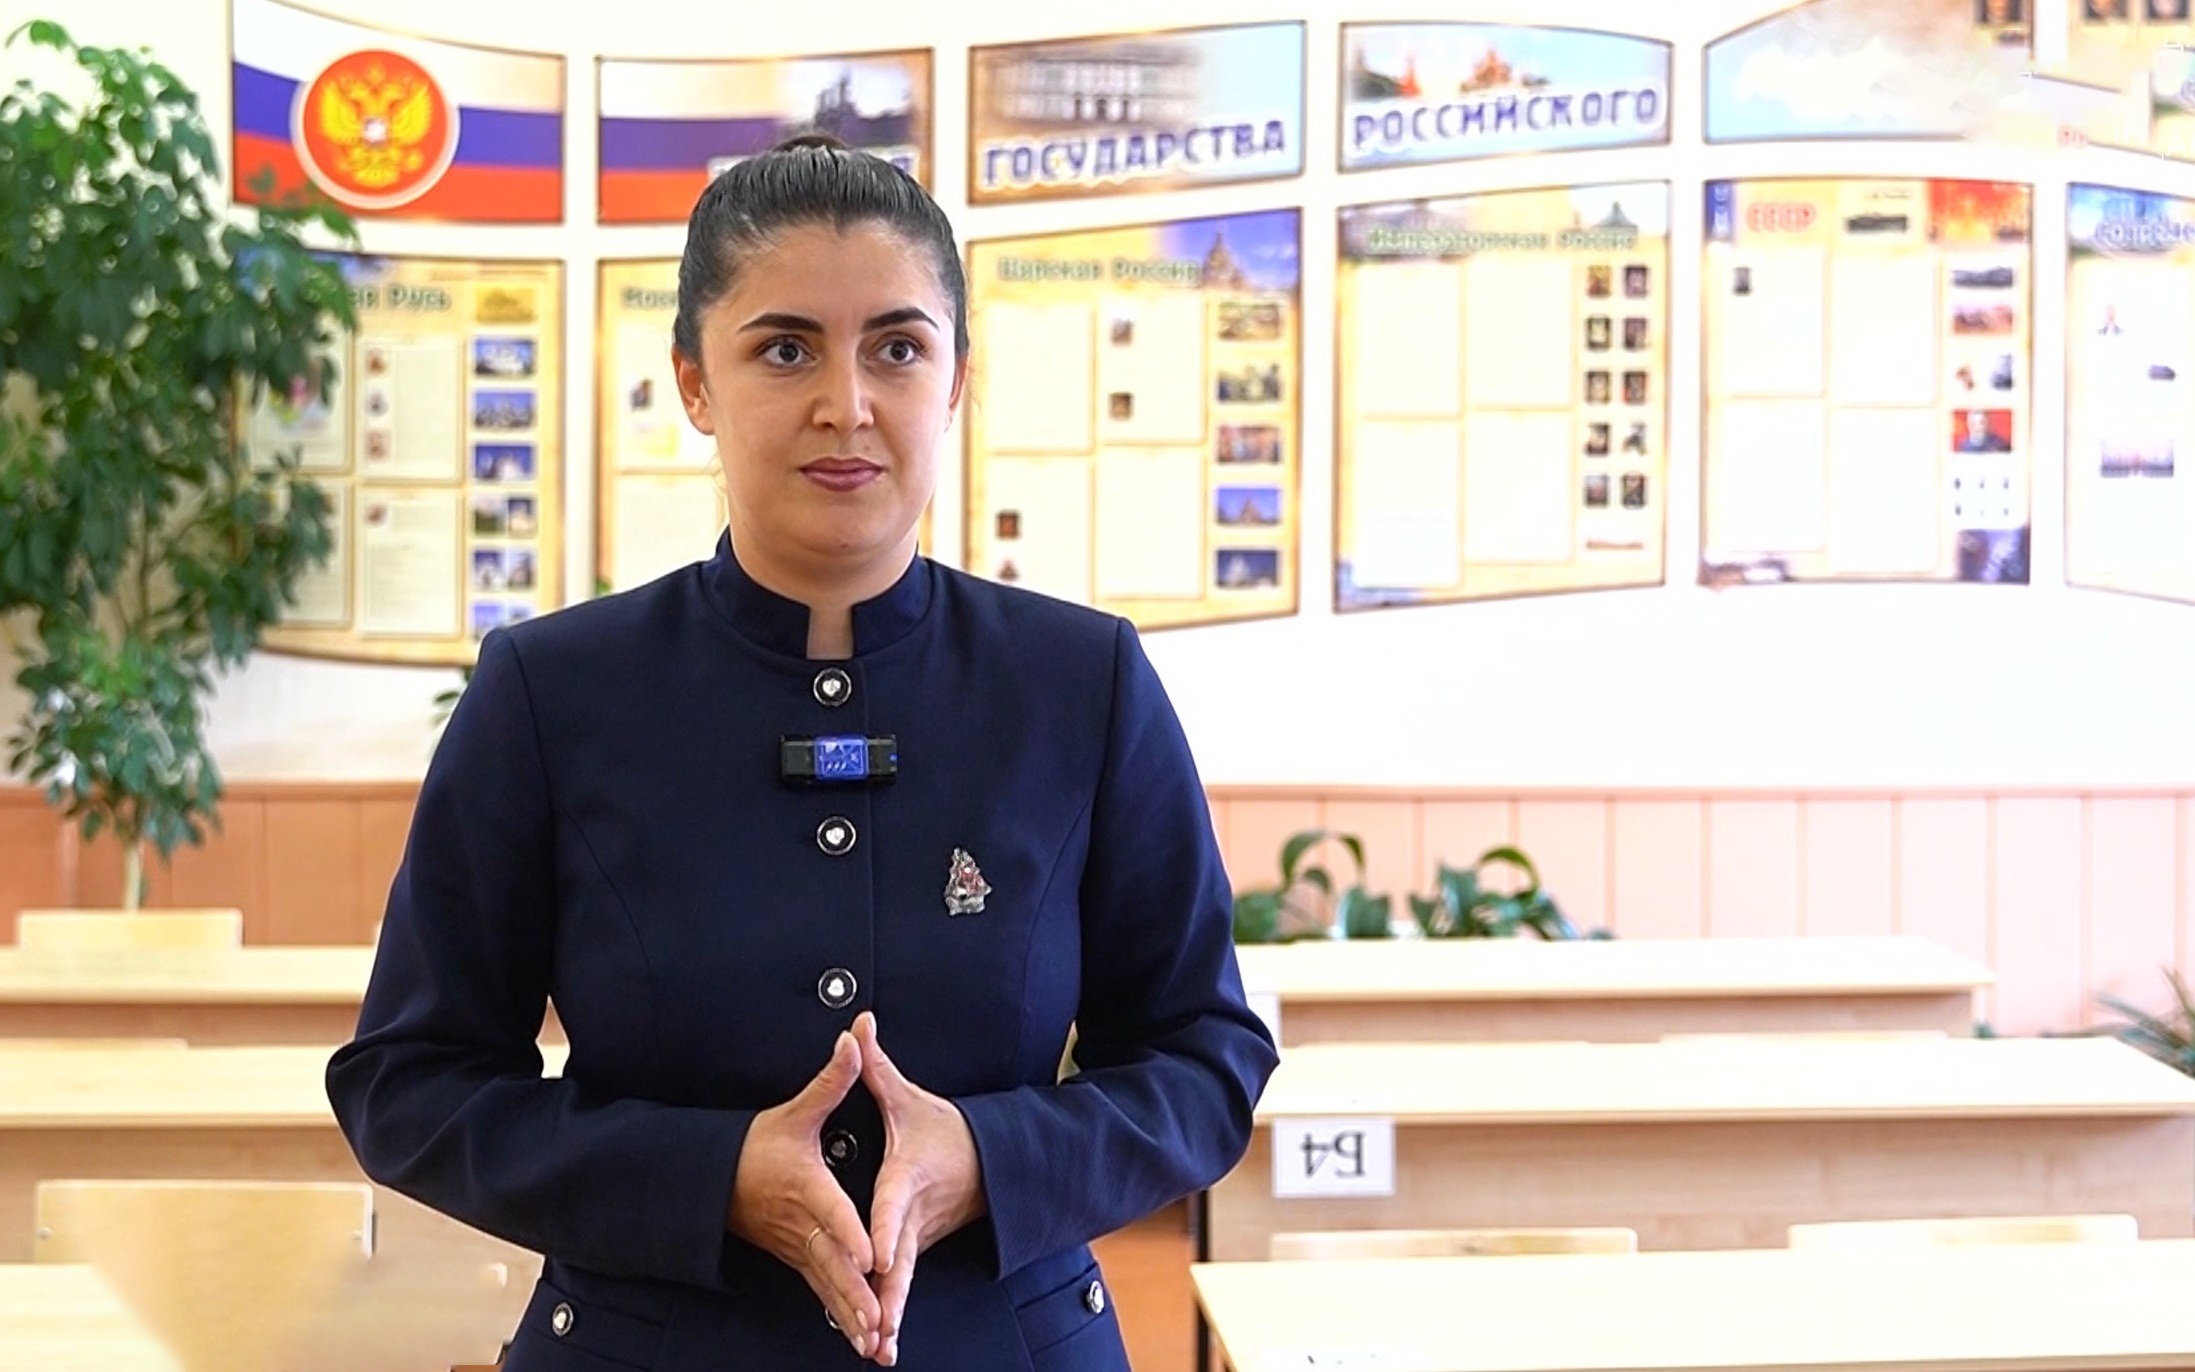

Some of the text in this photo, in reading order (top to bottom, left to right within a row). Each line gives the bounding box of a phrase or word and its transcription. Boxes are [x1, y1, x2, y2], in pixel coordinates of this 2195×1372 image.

[1353, 87, 1659, 149] РОССИЙСКОГО
[984, 119, 1286, 186] ГОСУДАРСТВА
[1299, 1129, 1367, 1178] Б4
